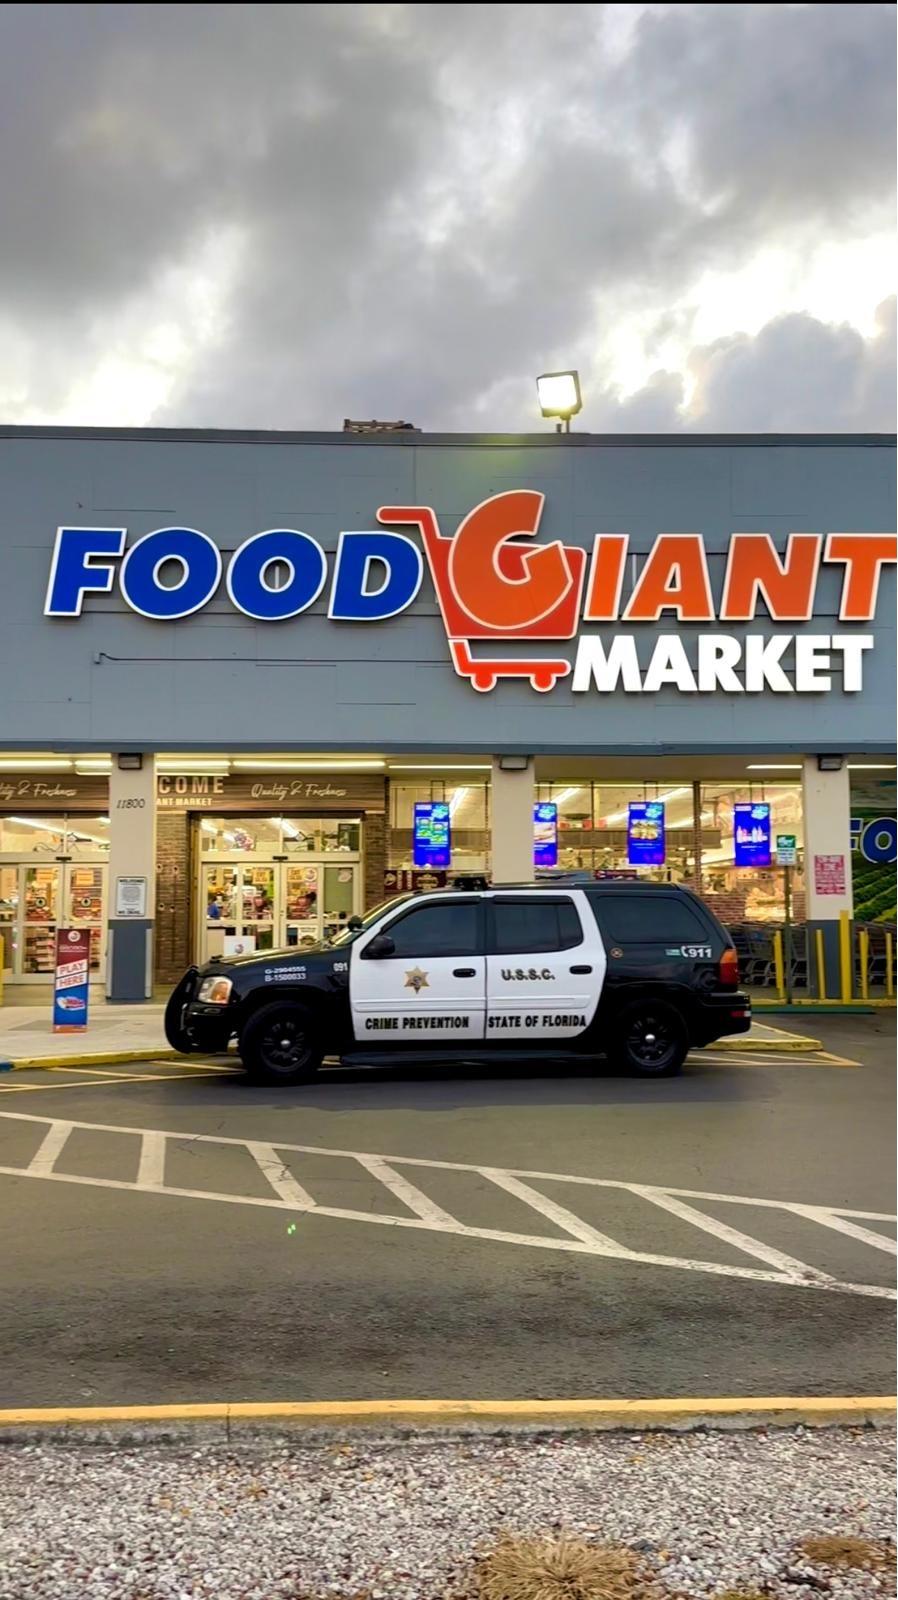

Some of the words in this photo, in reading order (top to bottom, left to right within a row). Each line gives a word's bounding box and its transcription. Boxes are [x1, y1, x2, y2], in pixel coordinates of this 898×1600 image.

[43, 526, 423, 621] FOOD
[447, 489, 898, 630] GIANT
[571, 634, 874, 692] MARKET
[251, 783, 289, 801] Quality
[116, 798, 145, 809] 11800
[175, 797, 213, 806] MARKET
[688, 948, 712, 959] 911
[60, 962, 84, 975] PLAY
[500, 968, 556, 981] U.S.S.C.
[60, 974, 84, 987] HERE
[365, 1017, 398, 1029] CRIME
[402, 1016, 469, 1029] PREVENTION
[488, 1016, 521, 1028] STATE
[525, 1015, 539, 1027] OF
[542, 1015, 586, 1027] FLORIDA
